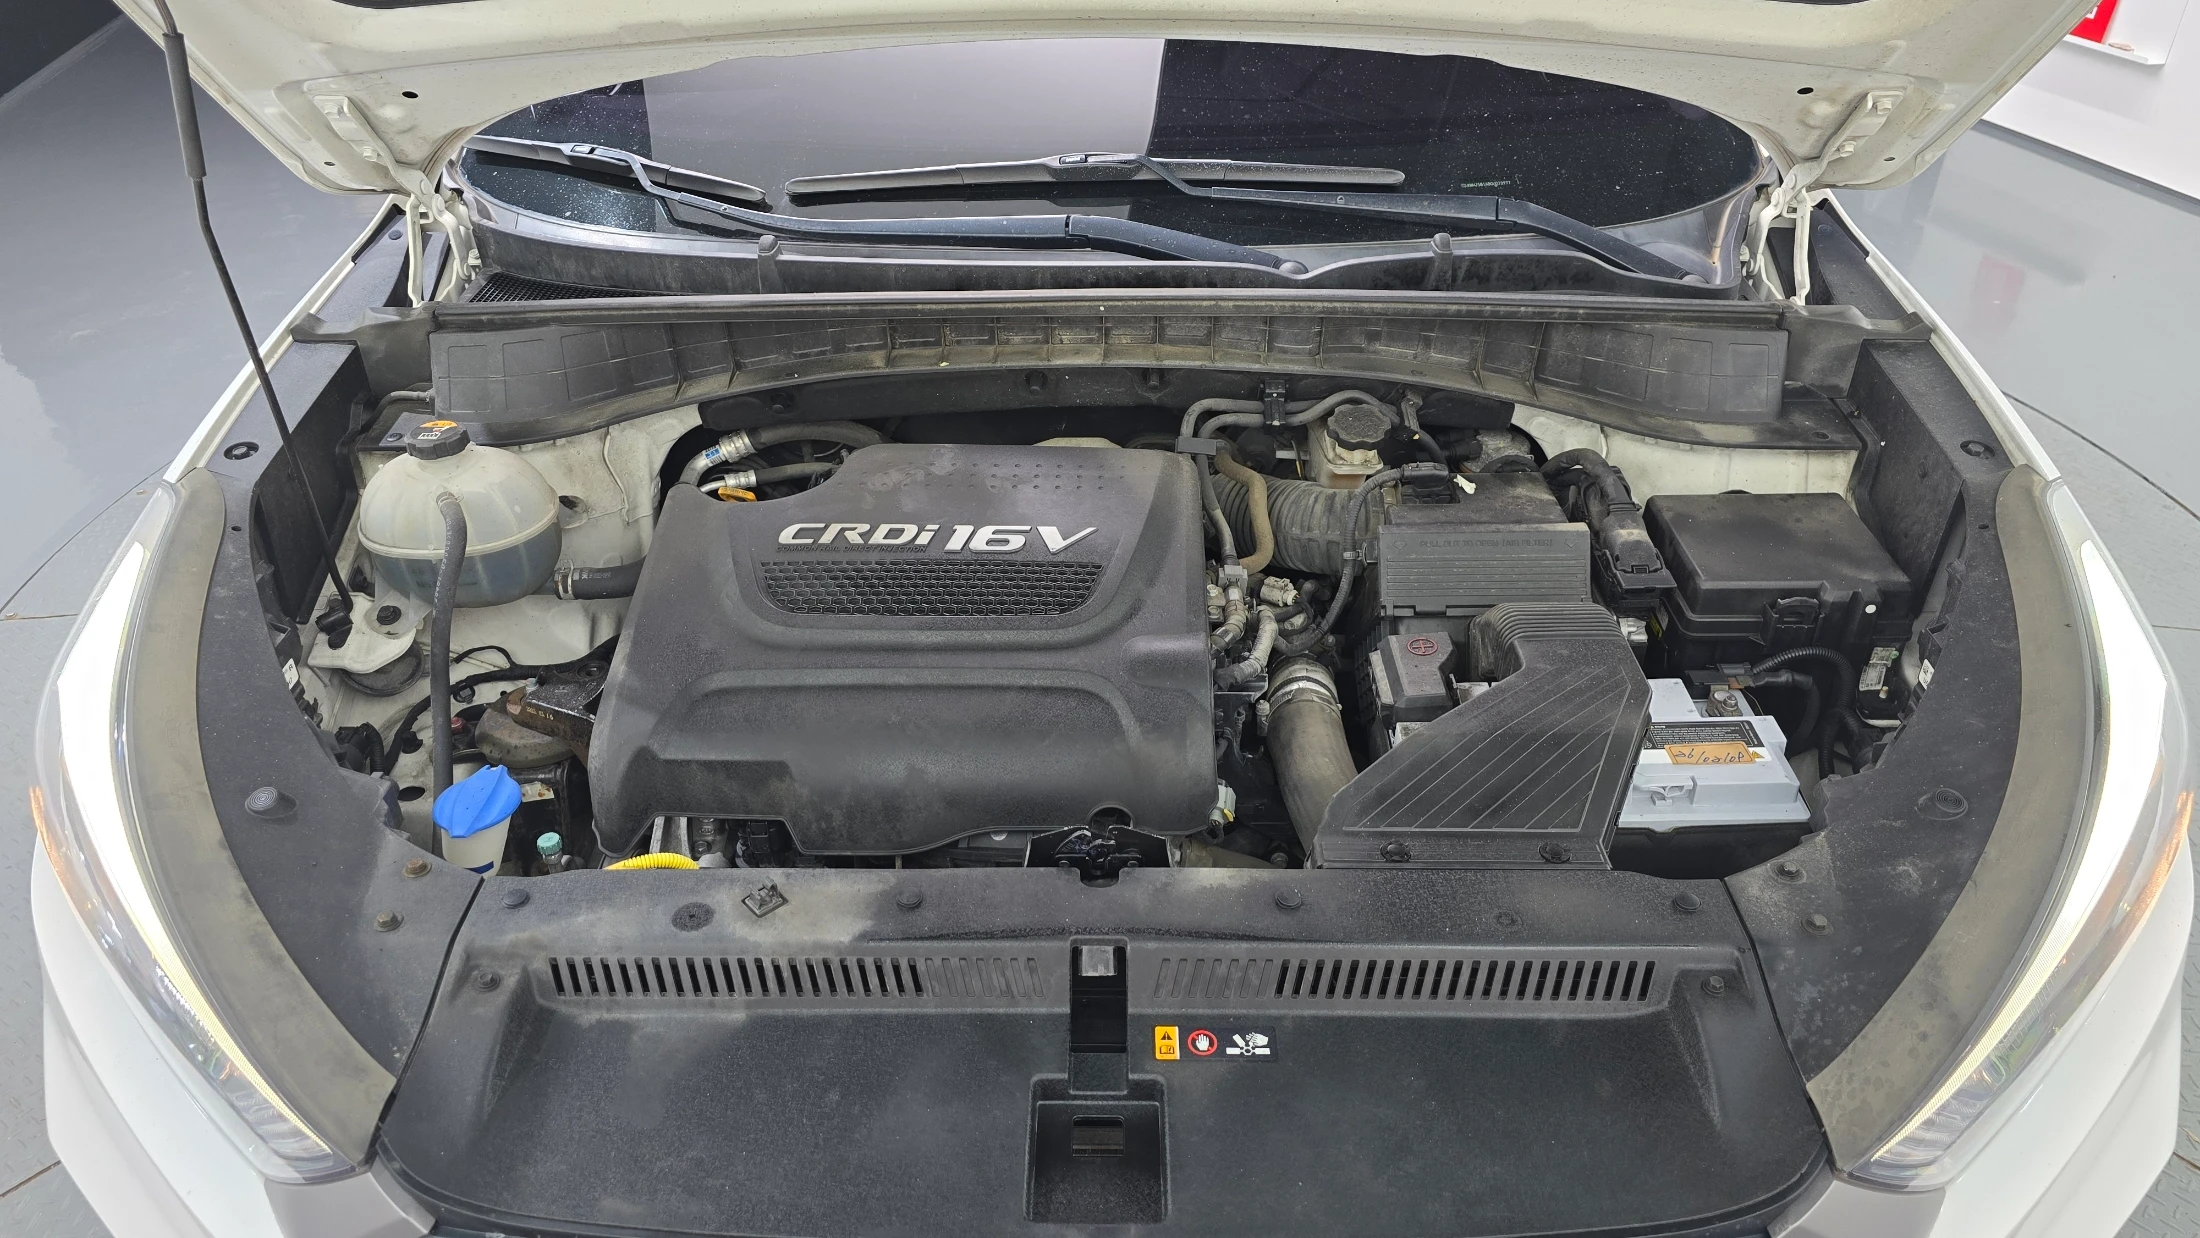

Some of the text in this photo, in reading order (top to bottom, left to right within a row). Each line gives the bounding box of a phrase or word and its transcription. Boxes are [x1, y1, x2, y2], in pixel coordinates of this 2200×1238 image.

[777, 523, 1099, 554] CRDi 16V
[1419, 539, 1440, 547] PULL
[1462, 539, 1474, 547] TO
[1475, 539, 1499, 547] OPEN
[776, 545, 927, 553] COMMON RAIL DIRECT INJECTION
